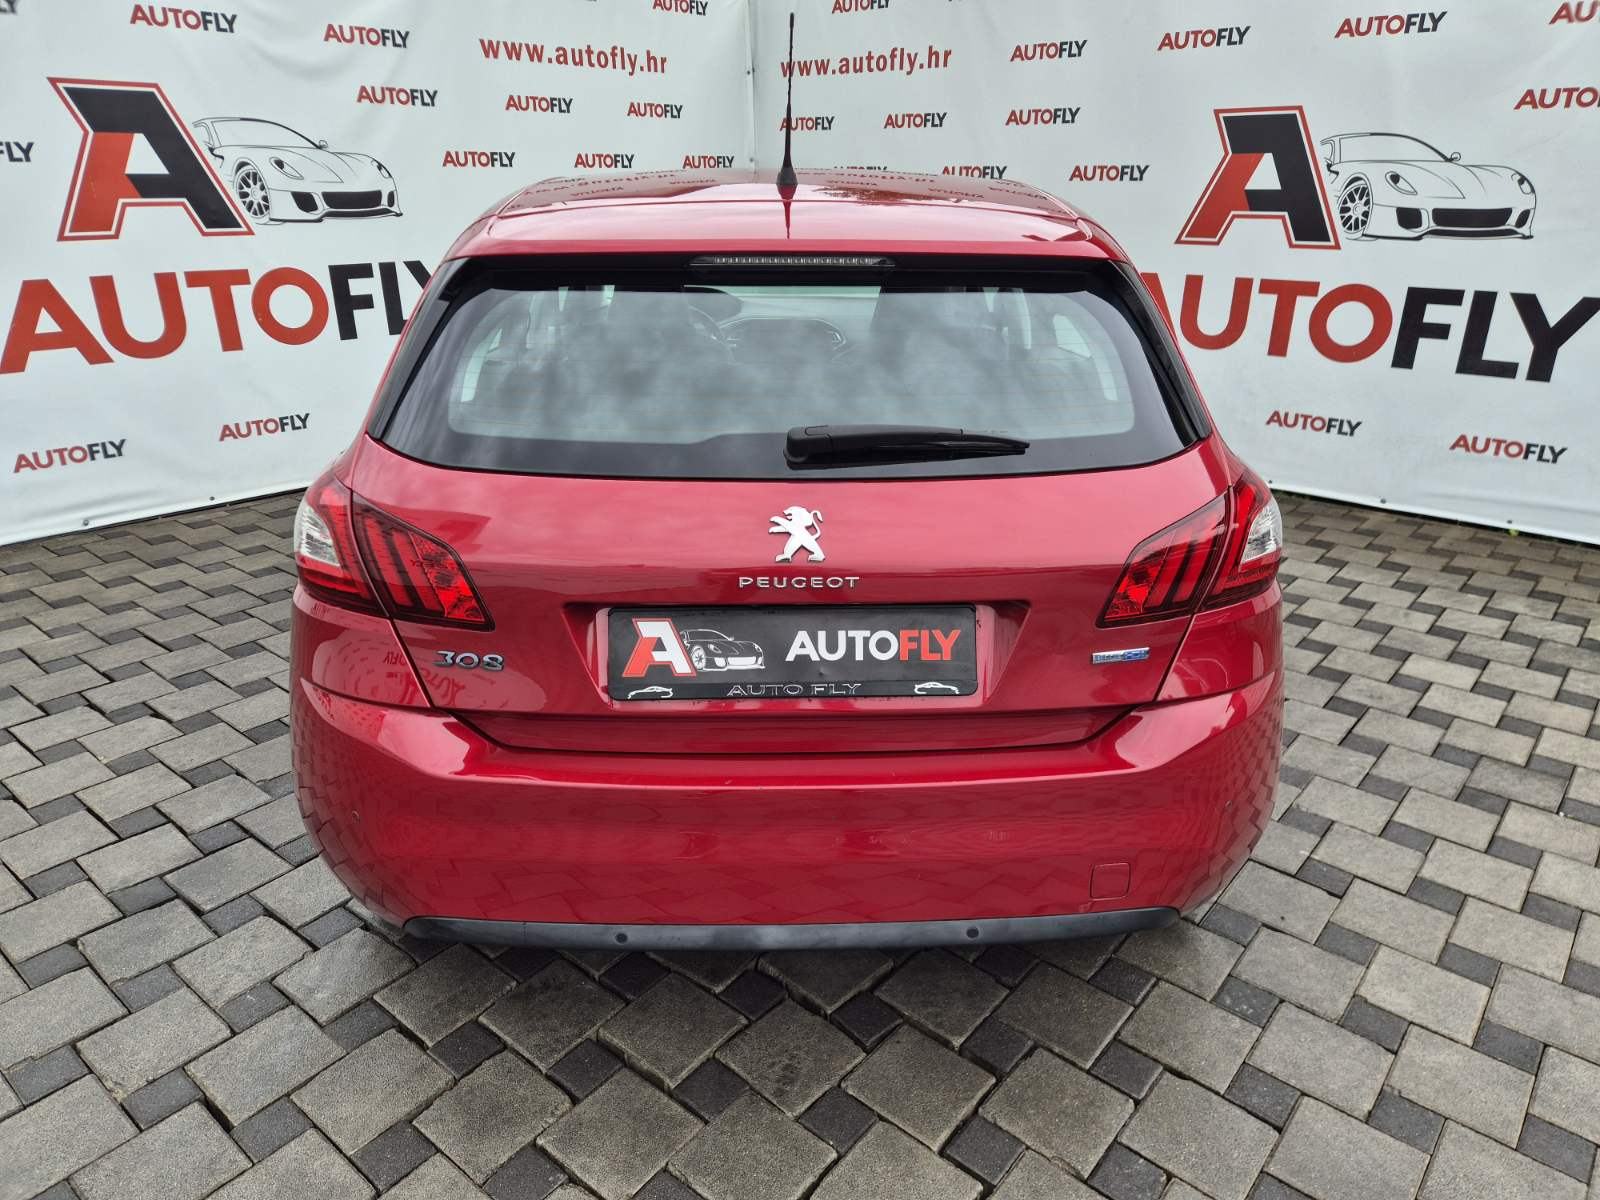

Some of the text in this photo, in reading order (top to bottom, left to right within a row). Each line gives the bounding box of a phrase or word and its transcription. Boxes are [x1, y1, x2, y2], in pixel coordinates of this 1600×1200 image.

[130, 4, 237, 33] AUTOFLY
[653, 0, 708, 16] AUTOFLY
[1334, 11, 1447, 38] AUTOFLY
[324, 24, 410, 48] AUTOFLY
[1157, 26, 1251, 51] AUTOFLY
[479, 38, 667, 76] www.autofly.hr
[780, 45, 952, 78] www.autofly.hr
[1010, 40, 1088, 62] AUTOFLY
[357, 85, 438, 107] AUTOFLY
[505, 95, 573, 114] AUTOFLY
[1514, 87, 1600, 110] AUTO
[627, 102, 683, 119] AUTOFLY
[884, 112, 947, 129] AUTOFLY
[1005, 107, 1080, 126] AUTOFLY
[443, 151, 515, 168] AUTOFLY
[574, 153, 634, 169] AUTOFLY
[682, 155, 734, 169] AUTOFLY
[1069, 165, 1149, 182] AUTOFLY
[219, 413, 310, 442] AUTOFLY
[1266, 410, 1362, 437] AUTOFLY
[14, 439, 126, 473] AUTOFLY
[1449, 434, 1567, 464] AUTOFLY
[739, 576, 860, 588] PEUGEOT
[785, 629, 961, 661] AUTOFLY
[434, 650, 505, 671] 308
[727, 683, 862, 696] AUTO FLY
